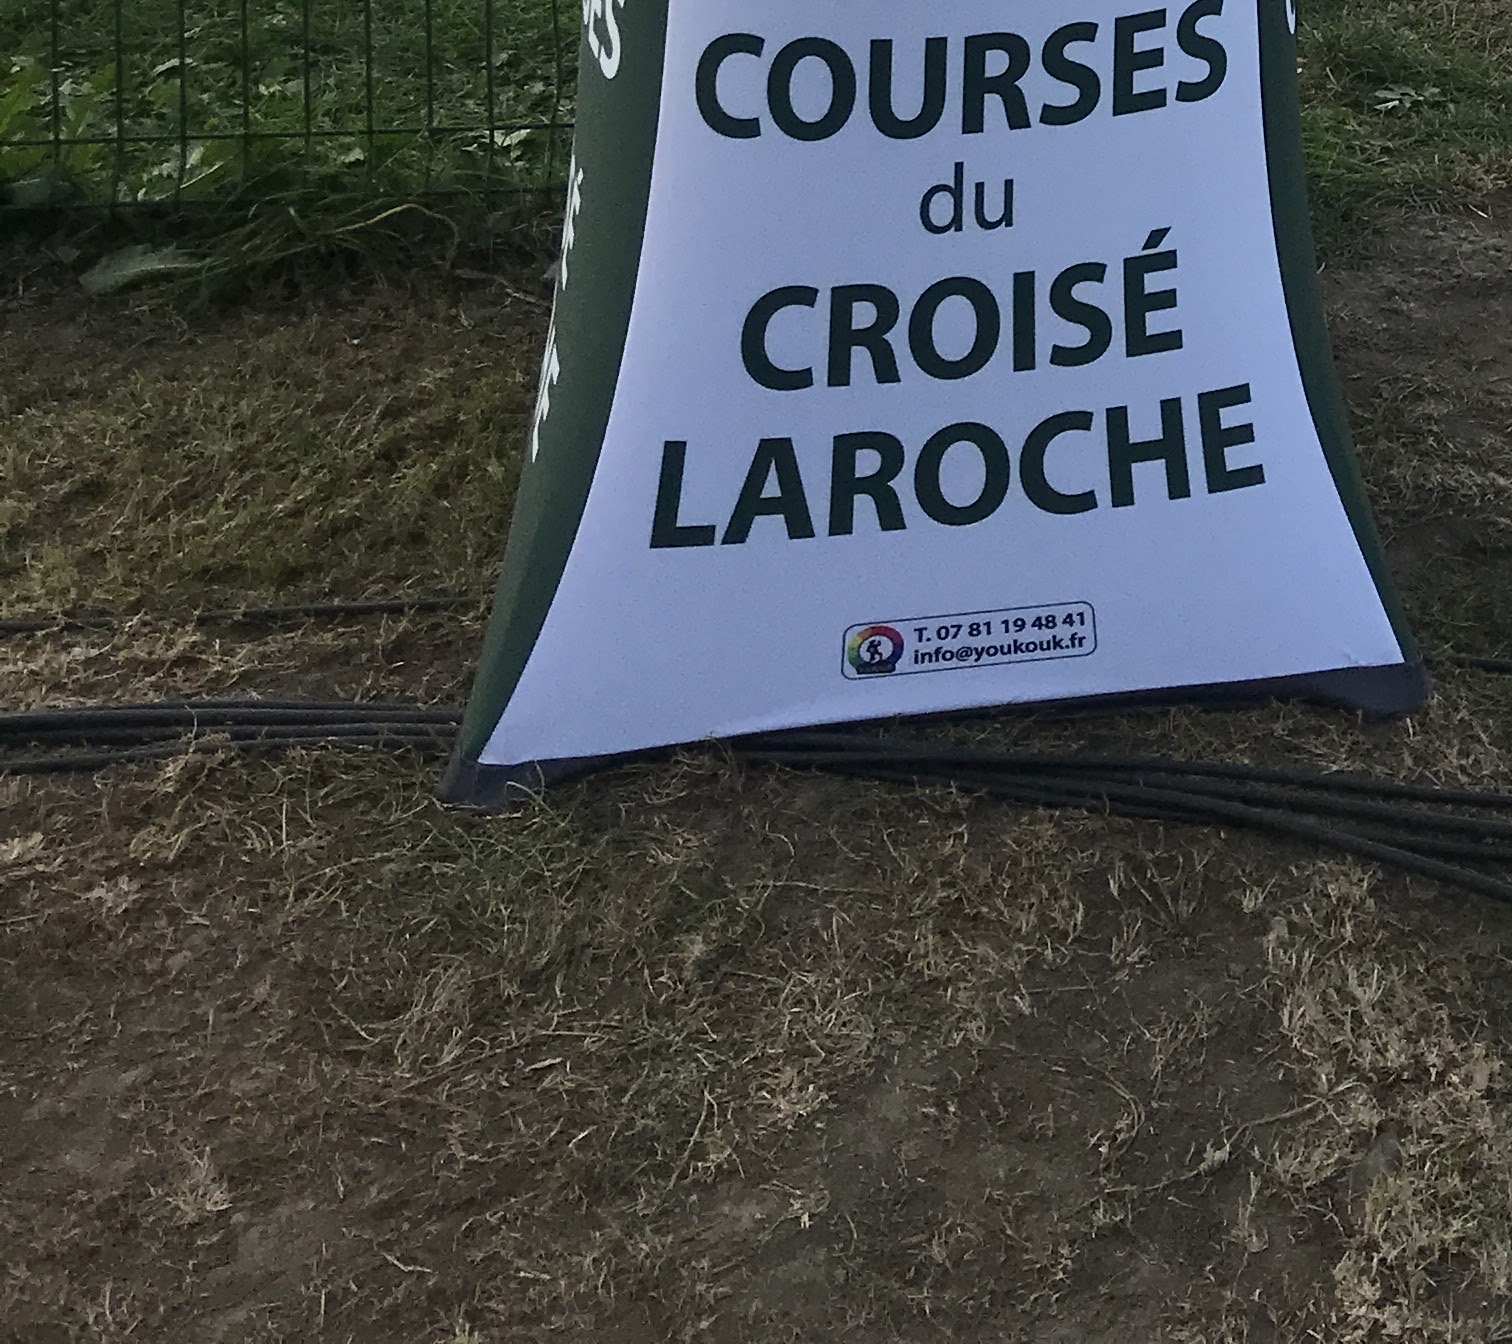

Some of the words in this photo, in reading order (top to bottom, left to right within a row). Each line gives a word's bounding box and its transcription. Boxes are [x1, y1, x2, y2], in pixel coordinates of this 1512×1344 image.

[918, 160, 1015, 235] du
[739, 226, 1184, 392] CROISÉ
[649, 382, 1265, 549] LAROCHE
[913, 627, 931, 644] T.
[936, 623, 963, 641] 07
[968, 620, 992, 638] 81
[1001, 617, 1027, 634] 19
[1031, 614, 1058, 631] 48
[1062, 611, 1086, 628] 41
[913, 632, 1087, 666] info@youkouk.fr
